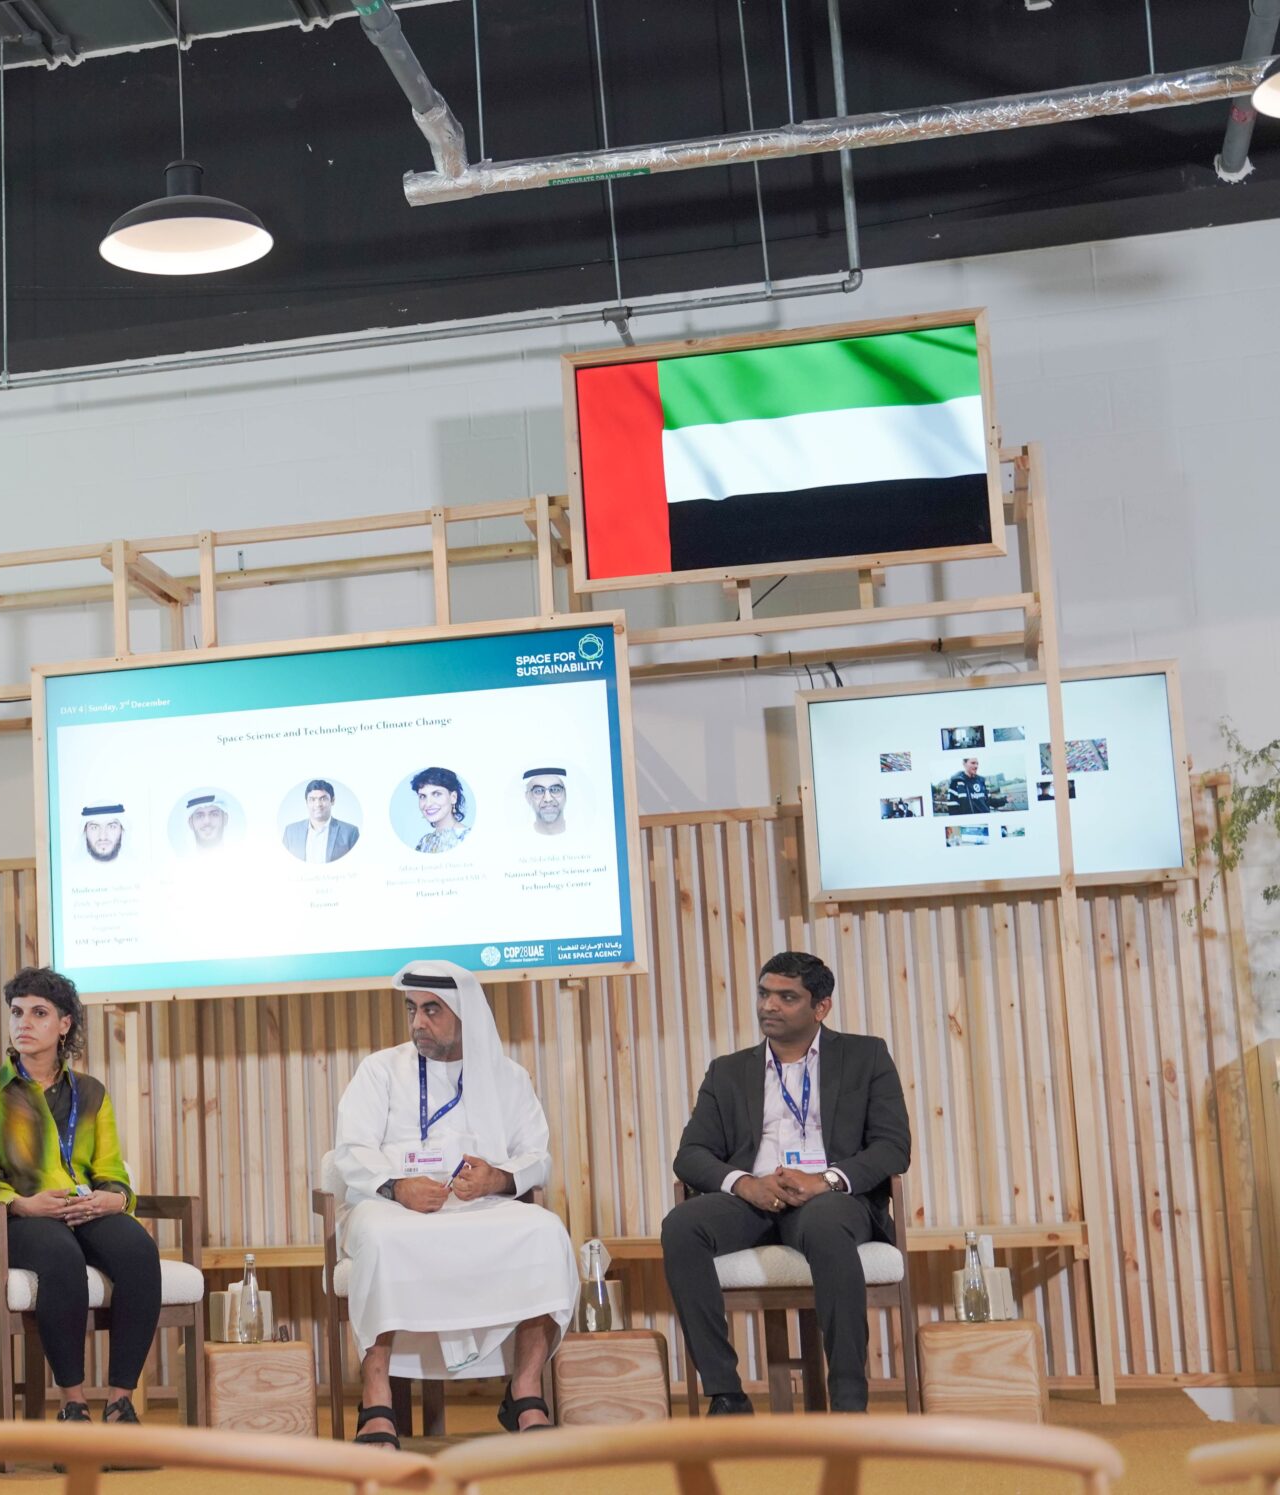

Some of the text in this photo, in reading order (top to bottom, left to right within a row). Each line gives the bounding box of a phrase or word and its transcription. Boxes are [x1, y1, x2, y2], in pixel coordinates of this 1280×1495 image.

[516, 651, 576, 666] SPACE FOR
[516, 660, 604, 677] SUSTAINABILITY
[60, 705, 77, 715] DAY
[78, 705, 84, 713] 4
[87, 702, 118, 713] Sunday,
[131, 698, 170, 709] December
[216, 716, 453, 746] Space Science and Technology for Climate Change
[504, 864, 607, 879] National Space Science and
[521, 881, 564, 891] Technology
[503, 944, 544, 959] COP28UAE
[558, 949, 622, 960] UAE SPACE AGENCY
